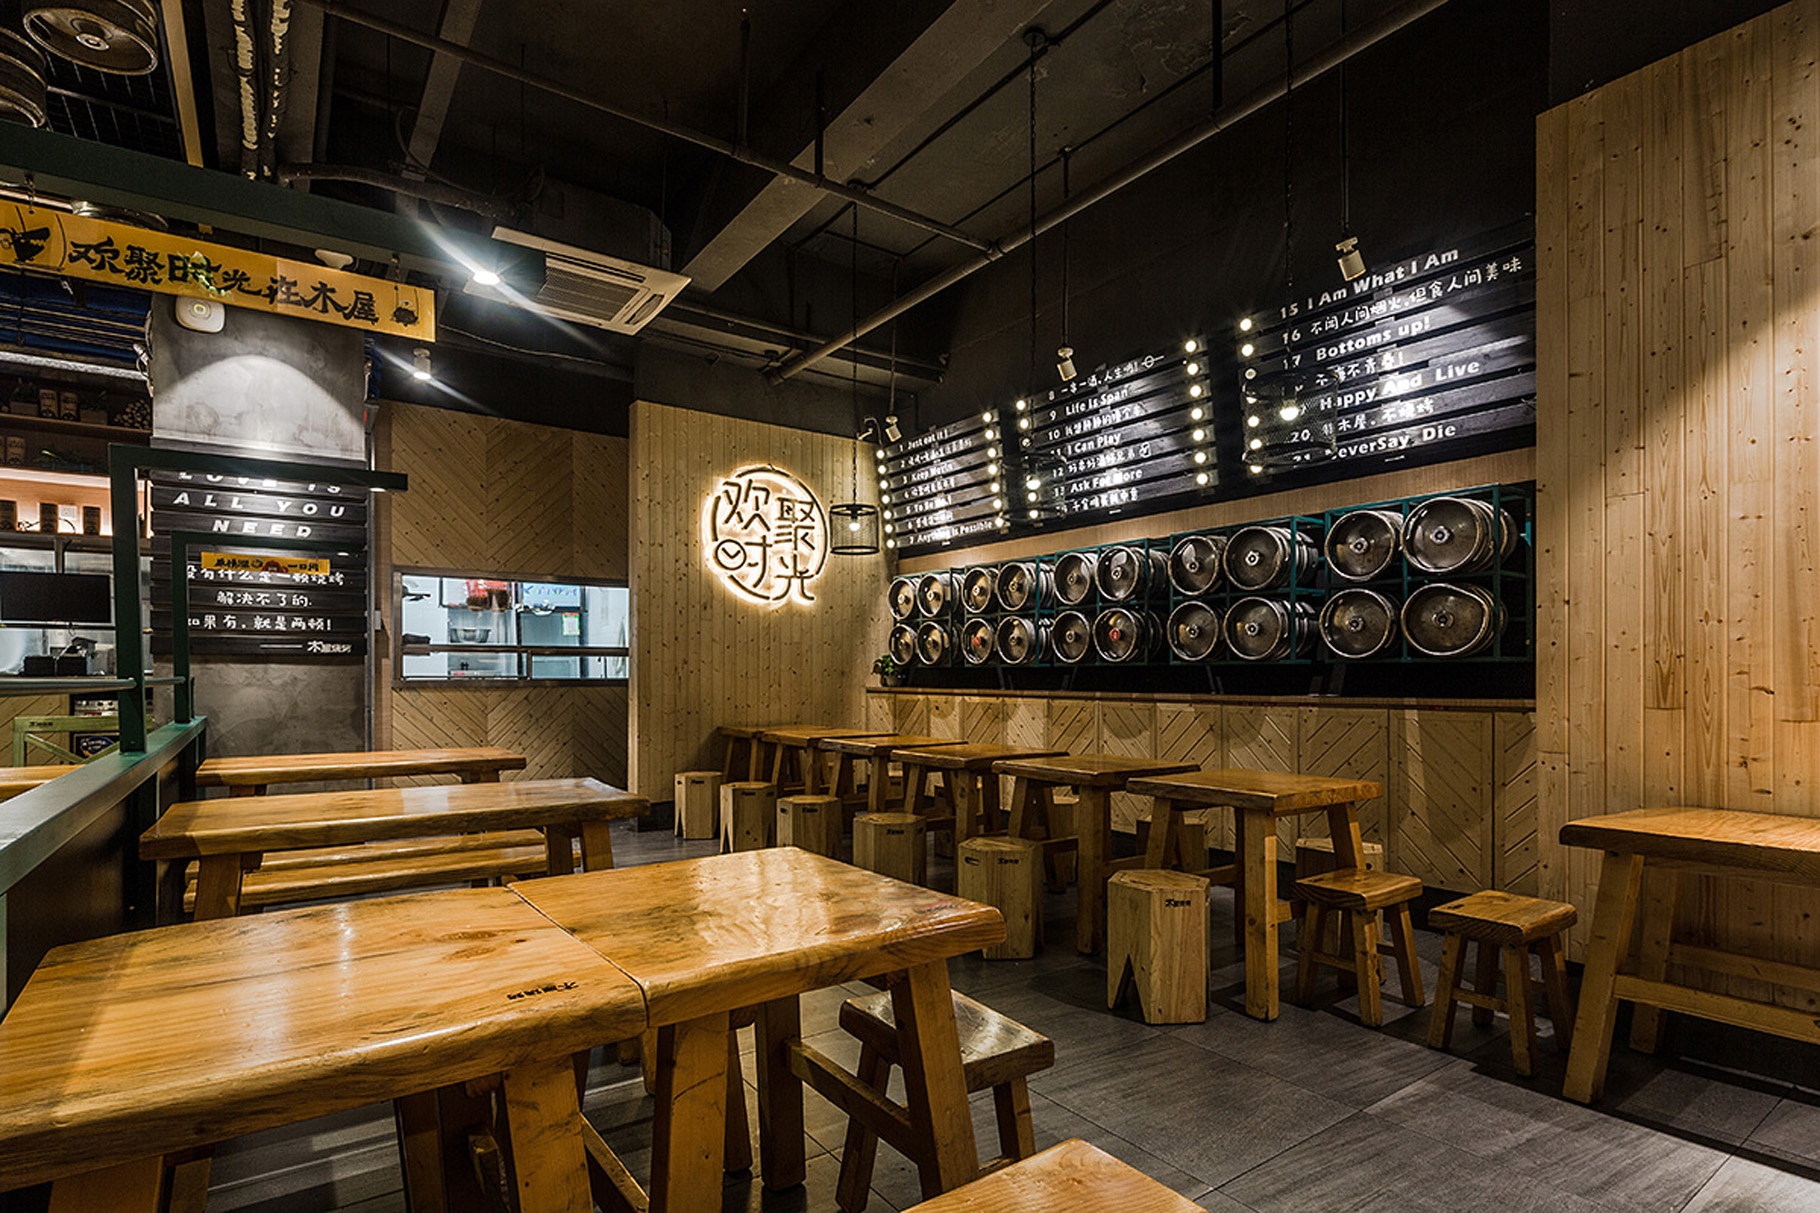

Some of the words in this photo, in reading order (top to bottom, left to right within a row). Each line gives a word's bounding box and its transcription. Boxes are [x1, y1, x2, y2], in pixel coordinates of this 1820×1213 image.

[1280, 306, 1299, 319] 15
[1307, 297, 1313, 310] I
[1318, 287, 1347, 306] Am
[1353, 267, 1405, 295] What
[1411, 261, 1418, 275] I
[1424, 249, 1459, 269] Am
[1282, 331, 1301, 345] 16
[1283, 355, 1301, 370] 17
[1315, 330, 1392, 361] Bottoms
[1398, 315, 1431, 339] up!
[1382, 375, 1422, 395] And
[1435, 361, 1480, 381] Live
[1049, 410, 1057, 421] 9
[1066, 402, 1086, 416] Life
[1048, 429, 1061, 441] 10
[1075, 441, 1095, 453] Can
[1097, 433, 1121, 448] Play
[1291, 429, 1311, 443] 20
[1422, 425, 1456, 442] Die
[1070, 481, 1090, 493] Ask
[173, 492, 244, 509] ALL
[277, 500, 345, 517] YOU
[212, 519, 311, 538] NEED
